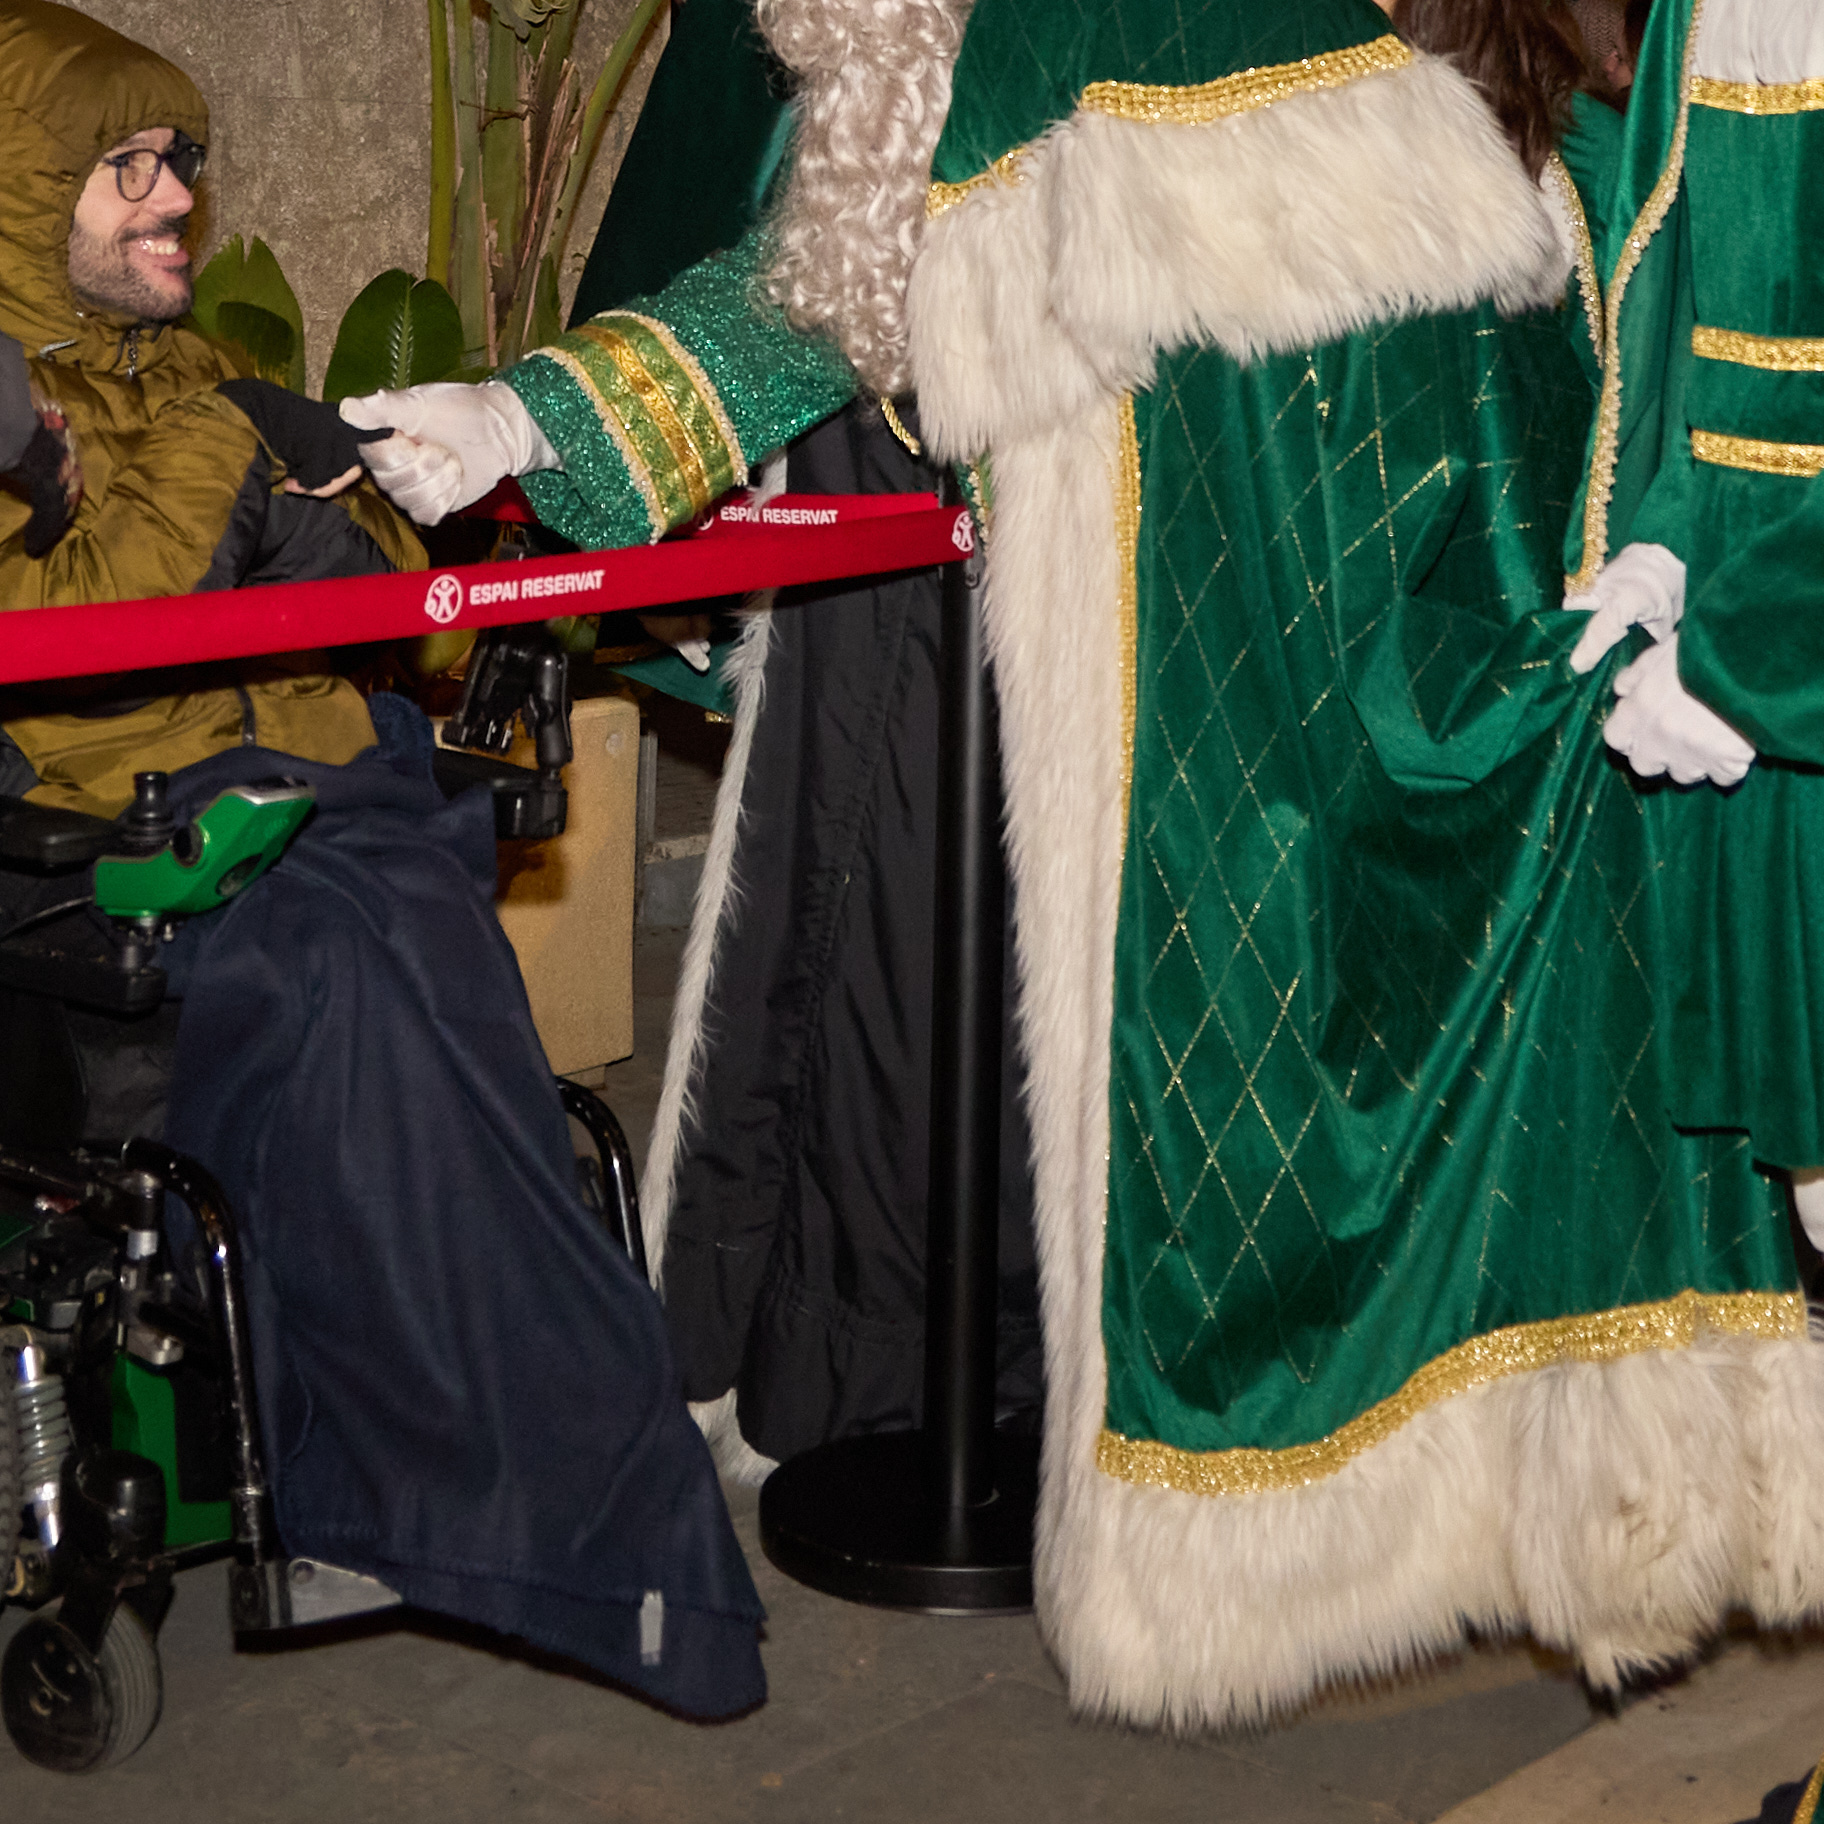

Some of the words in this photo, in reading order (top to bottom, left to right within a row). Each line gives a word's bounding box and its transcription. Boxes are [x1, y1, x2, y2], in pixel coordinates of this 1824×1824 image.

[762, 508, 838, 525] RESERVAT
[469, 579, 519, 605] ESPAI
[521, 569, 606, 600] RESERVAT
